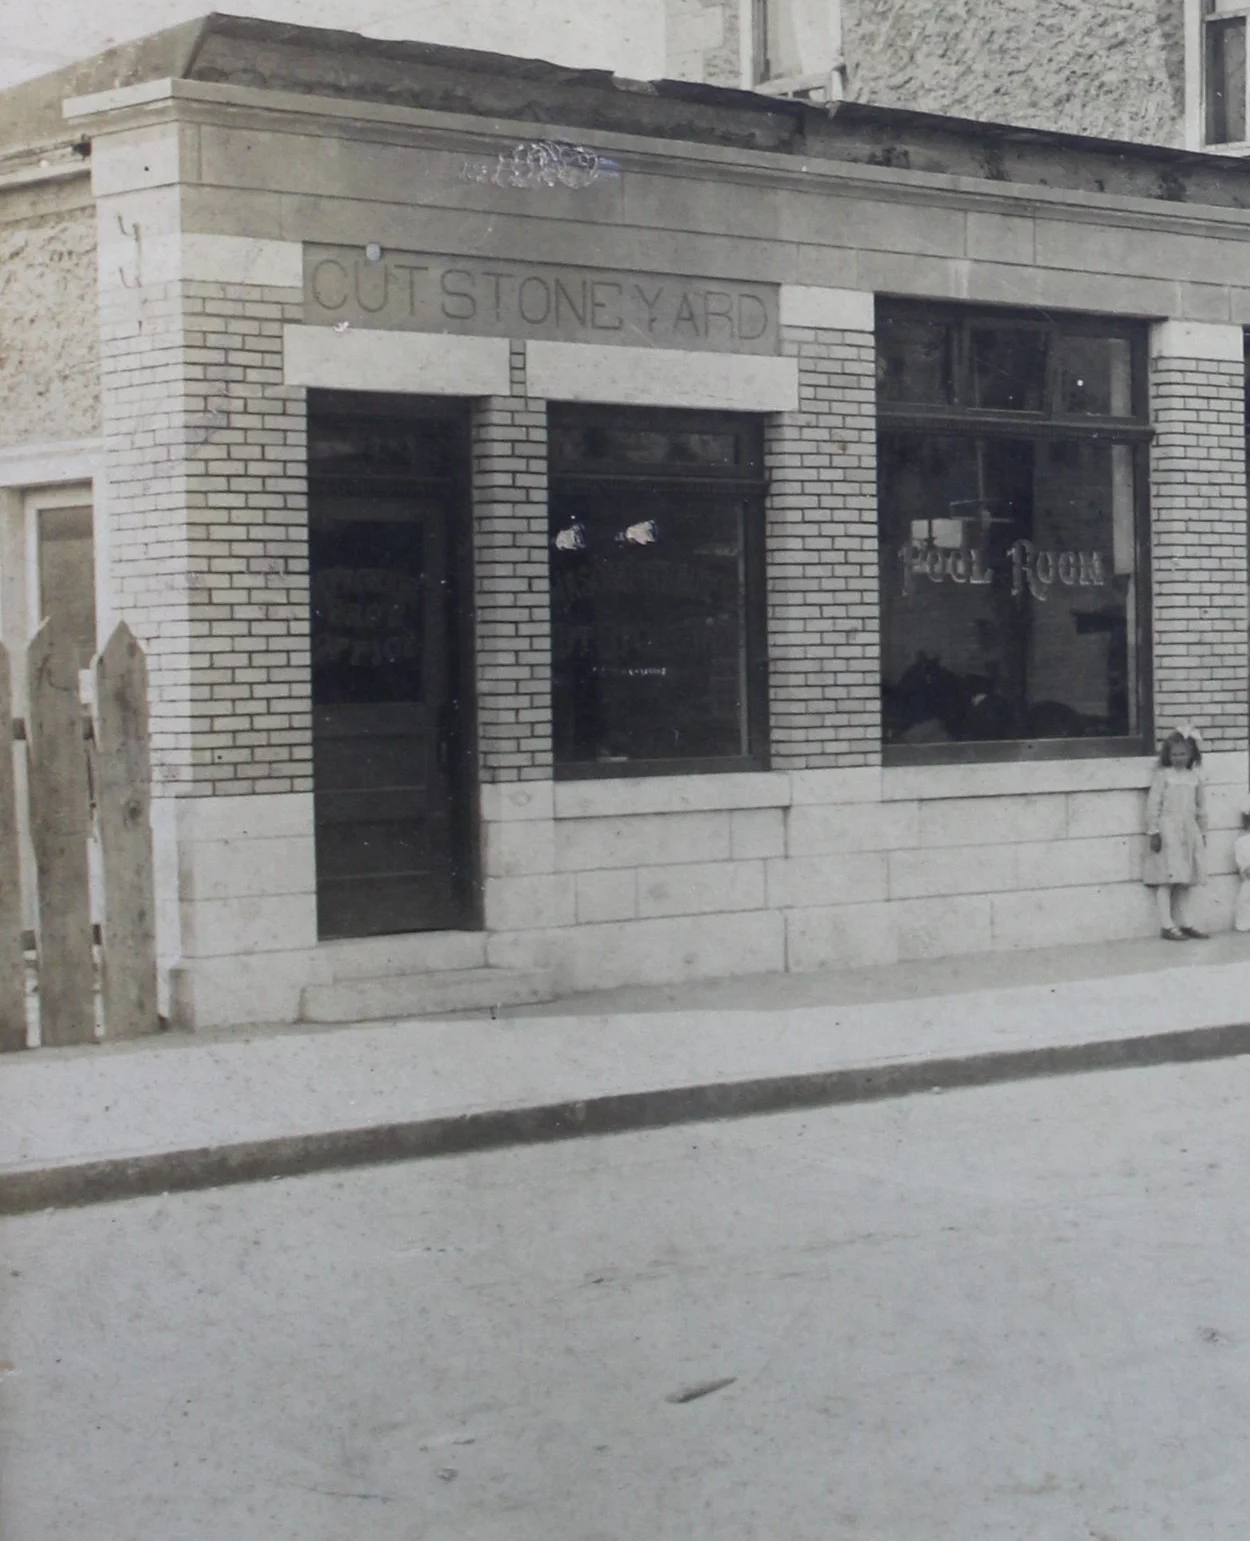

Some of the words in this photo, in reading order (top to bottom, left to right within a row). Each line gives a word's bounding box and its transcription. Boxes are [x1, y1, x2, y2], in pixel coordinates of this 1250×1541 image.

[310, 258, 429, 317] CUT
[440, 268, 624, 331] STONE
[634, 283, 769, 341] YARD
[1007, 539, 1106, 601] ROOM
